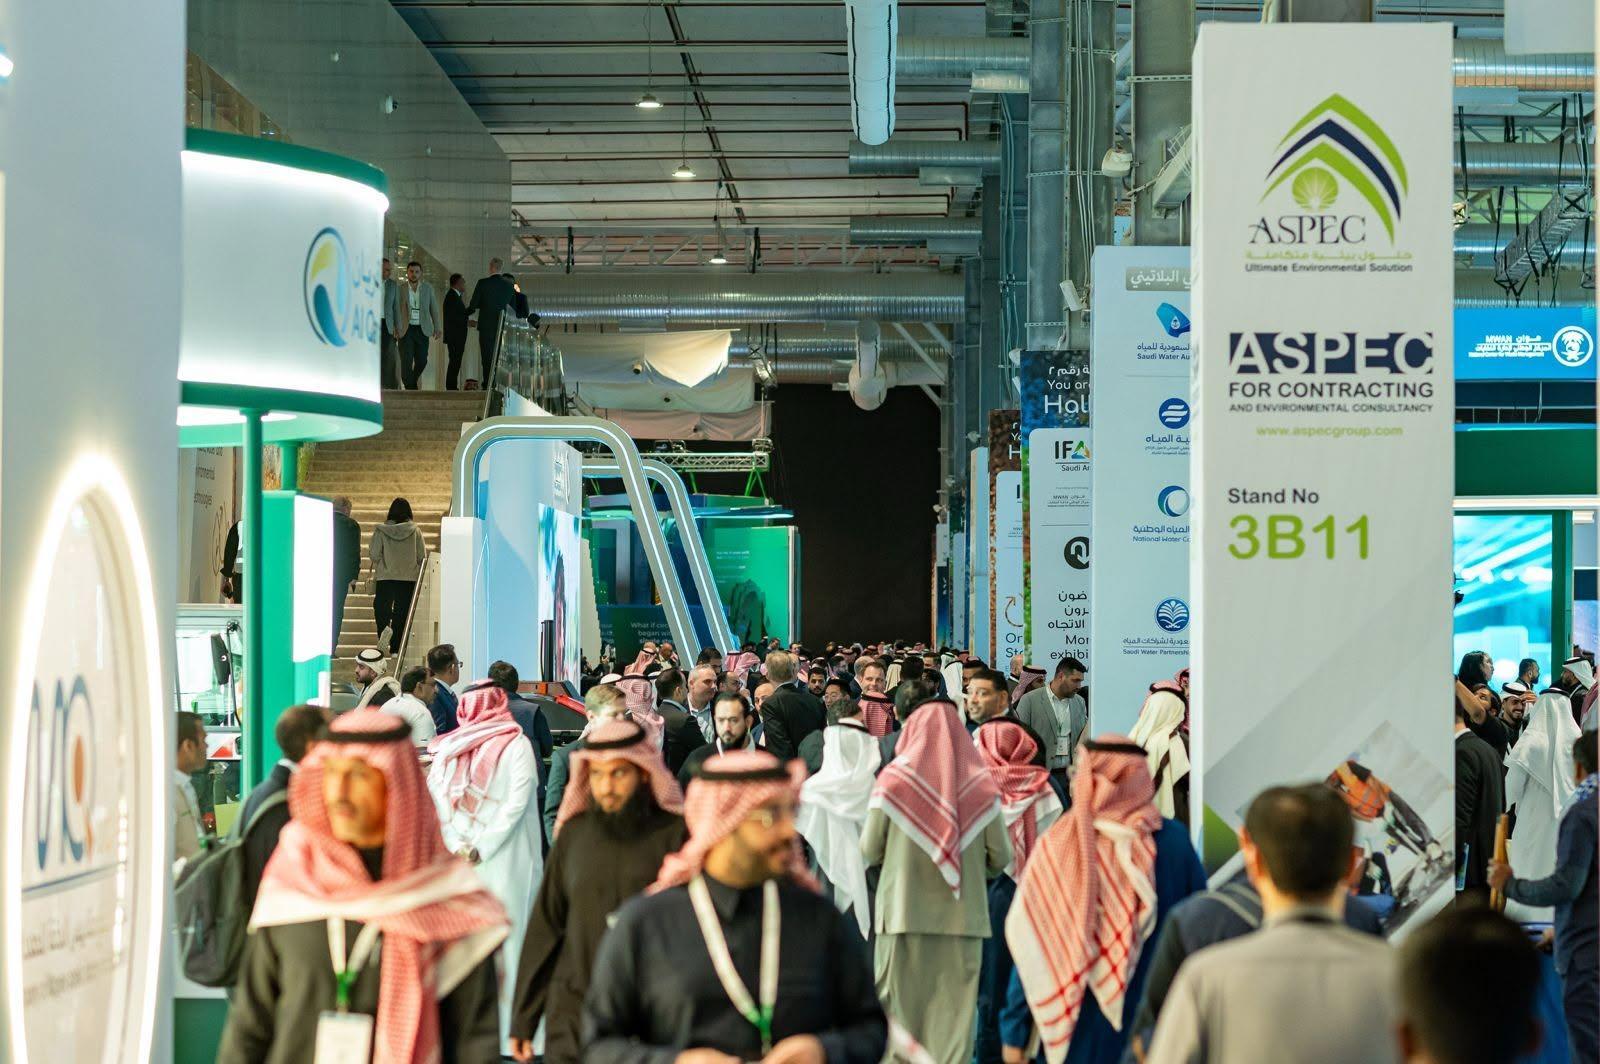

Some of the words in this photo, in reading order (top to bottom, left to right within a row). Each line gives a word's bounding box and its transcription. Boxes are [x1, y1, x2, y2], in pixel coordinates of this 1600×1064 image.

[1248, 215, 1366, 244] ASPEC
[1245, 263, 1288, 272] Ultimate
[1291, 263, 1365, 272] Environmental
[1369, 263, 1413, 272] Solution
[1130, 269, 1179, 289] البلاتيني
[1229, 332, 1434, 374] ASPEC
[1047, 380, 1071, 389] You
[1229, 382, 1271, 398] FOR
[1278, 382, 1434, 398] CONTRACTING
[1229, 403, 1253, 412] AND
[1256, 403, 1349, 412] ENVIRONMENTAL
[1352, 403, 1433, 412] CONSULTANCY
[1256, 425, 1404, 439] www.aspecgroup.com
[1145, 434, 1174, 445] المياه
[1061, 464, 1081, 472] Saudi
[1228, 488, 1286, 504] Stand
[1292, 488, 1320, 504] No
[1228, 514, 1368, 560] 3B11
[1048, 619, 1085, 631] الاتجاه
